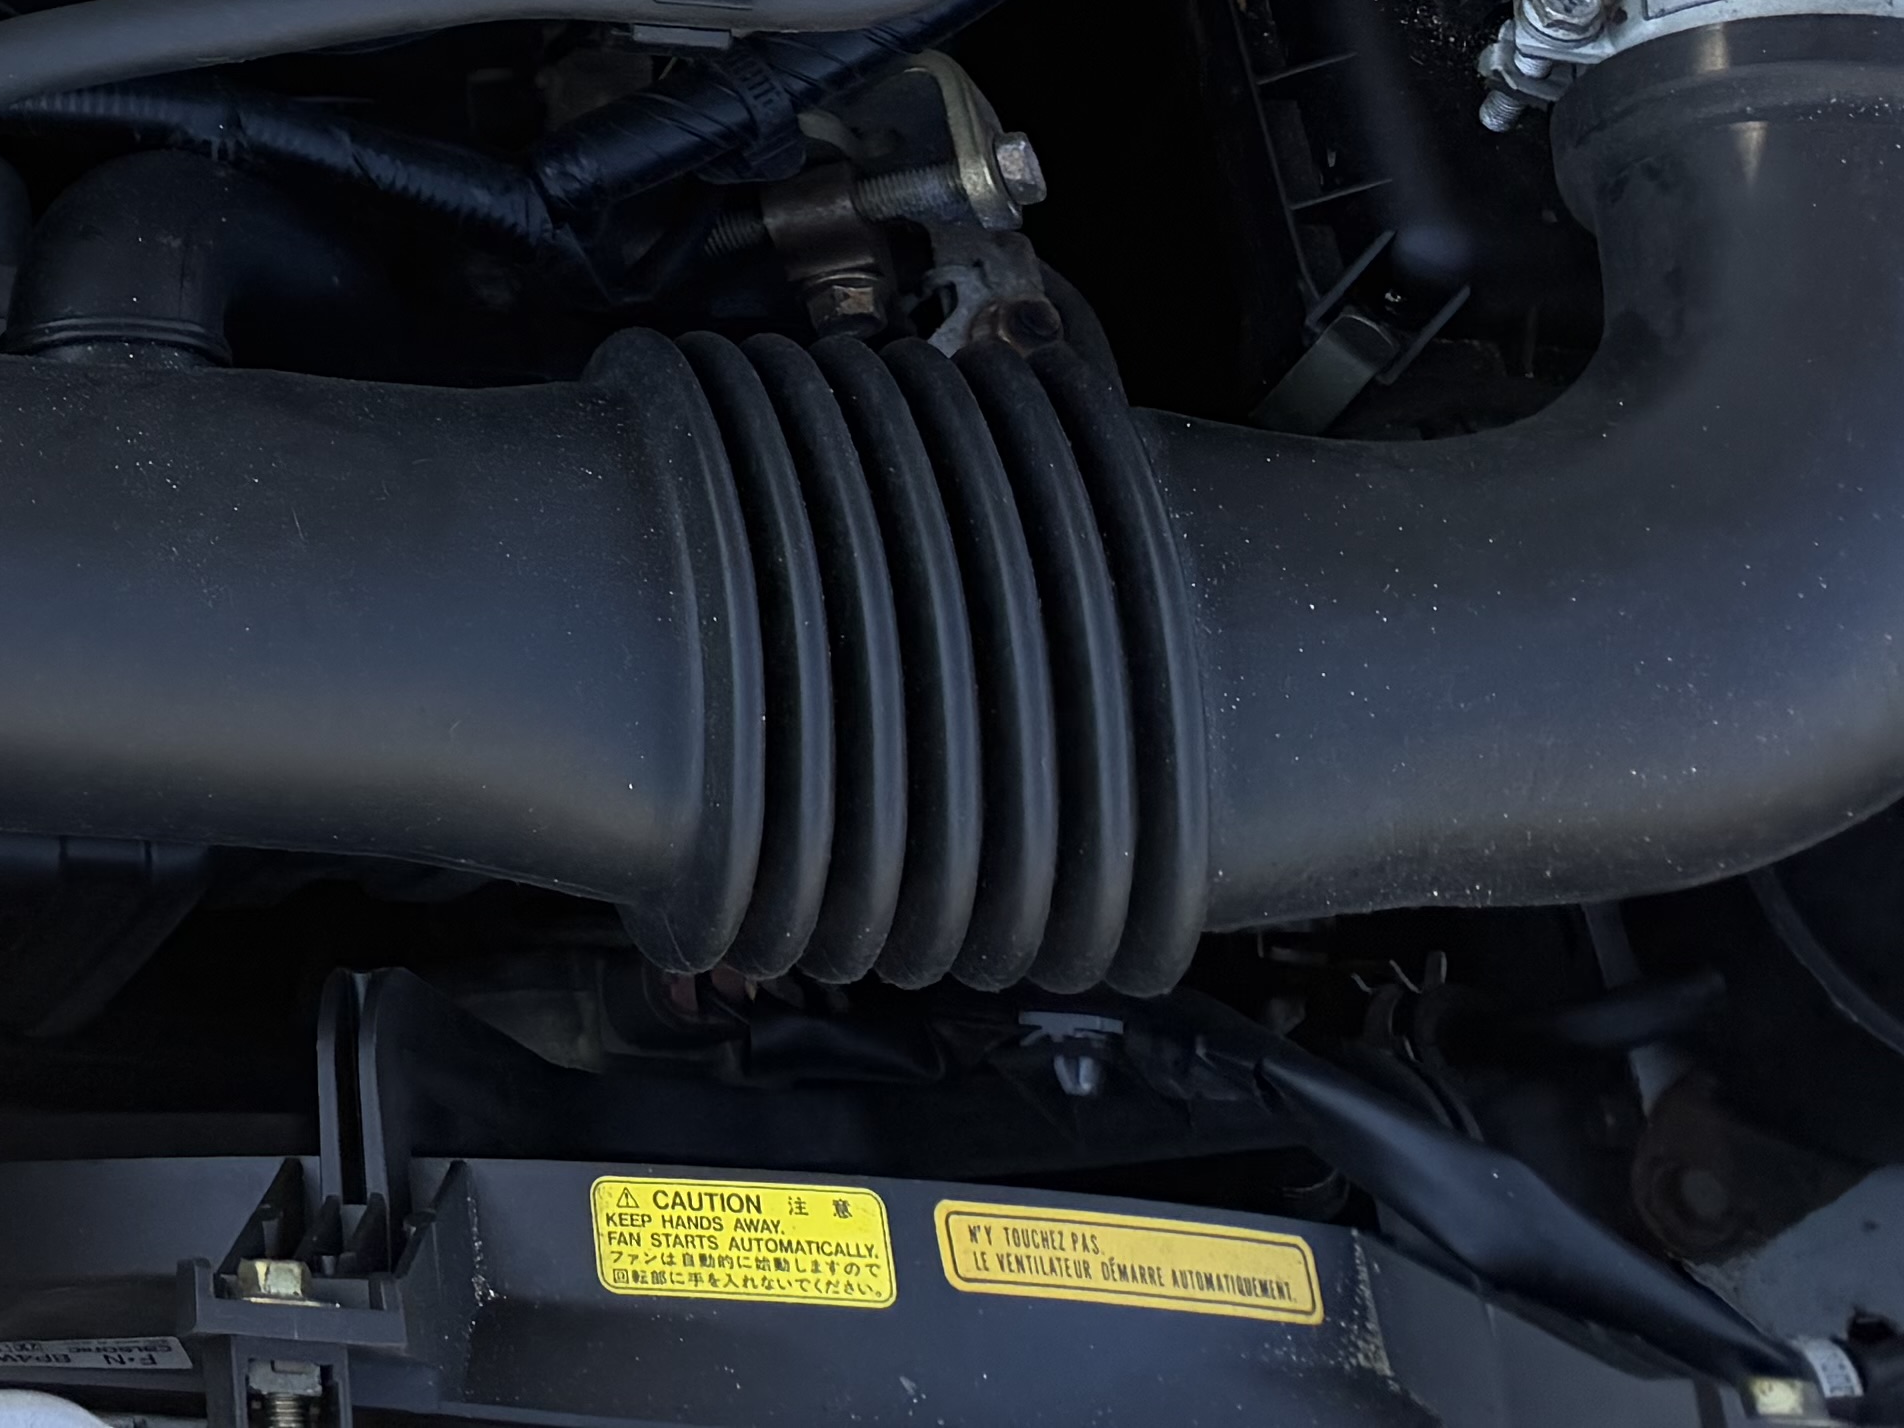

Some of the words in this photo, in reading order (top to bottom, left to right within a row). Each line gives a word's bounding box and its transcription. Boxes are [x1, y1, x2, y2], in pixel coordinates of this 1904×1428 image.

[652, 1189, 761, 1213] CAUTION
[605, 1212, 652, 1227] KEEP
[661, 1214, 723, 1231] HANDS
[733, 1217, 784, 1234] AWAY.
[606, 1230, 641, 1247] FAN
[650, 1232, 718, 1250] STARTS
[728, 1236, 877, 1258] AUTOMATICALLY.
[1003, 1226, 1065, 1251] TOUCHEZ
[972, 1250, 989, 1272] LE
[996, 1252, 1091, 1278] VENTILATEUR
[1100, 1257, 1164, 1286] DÉMARRE
